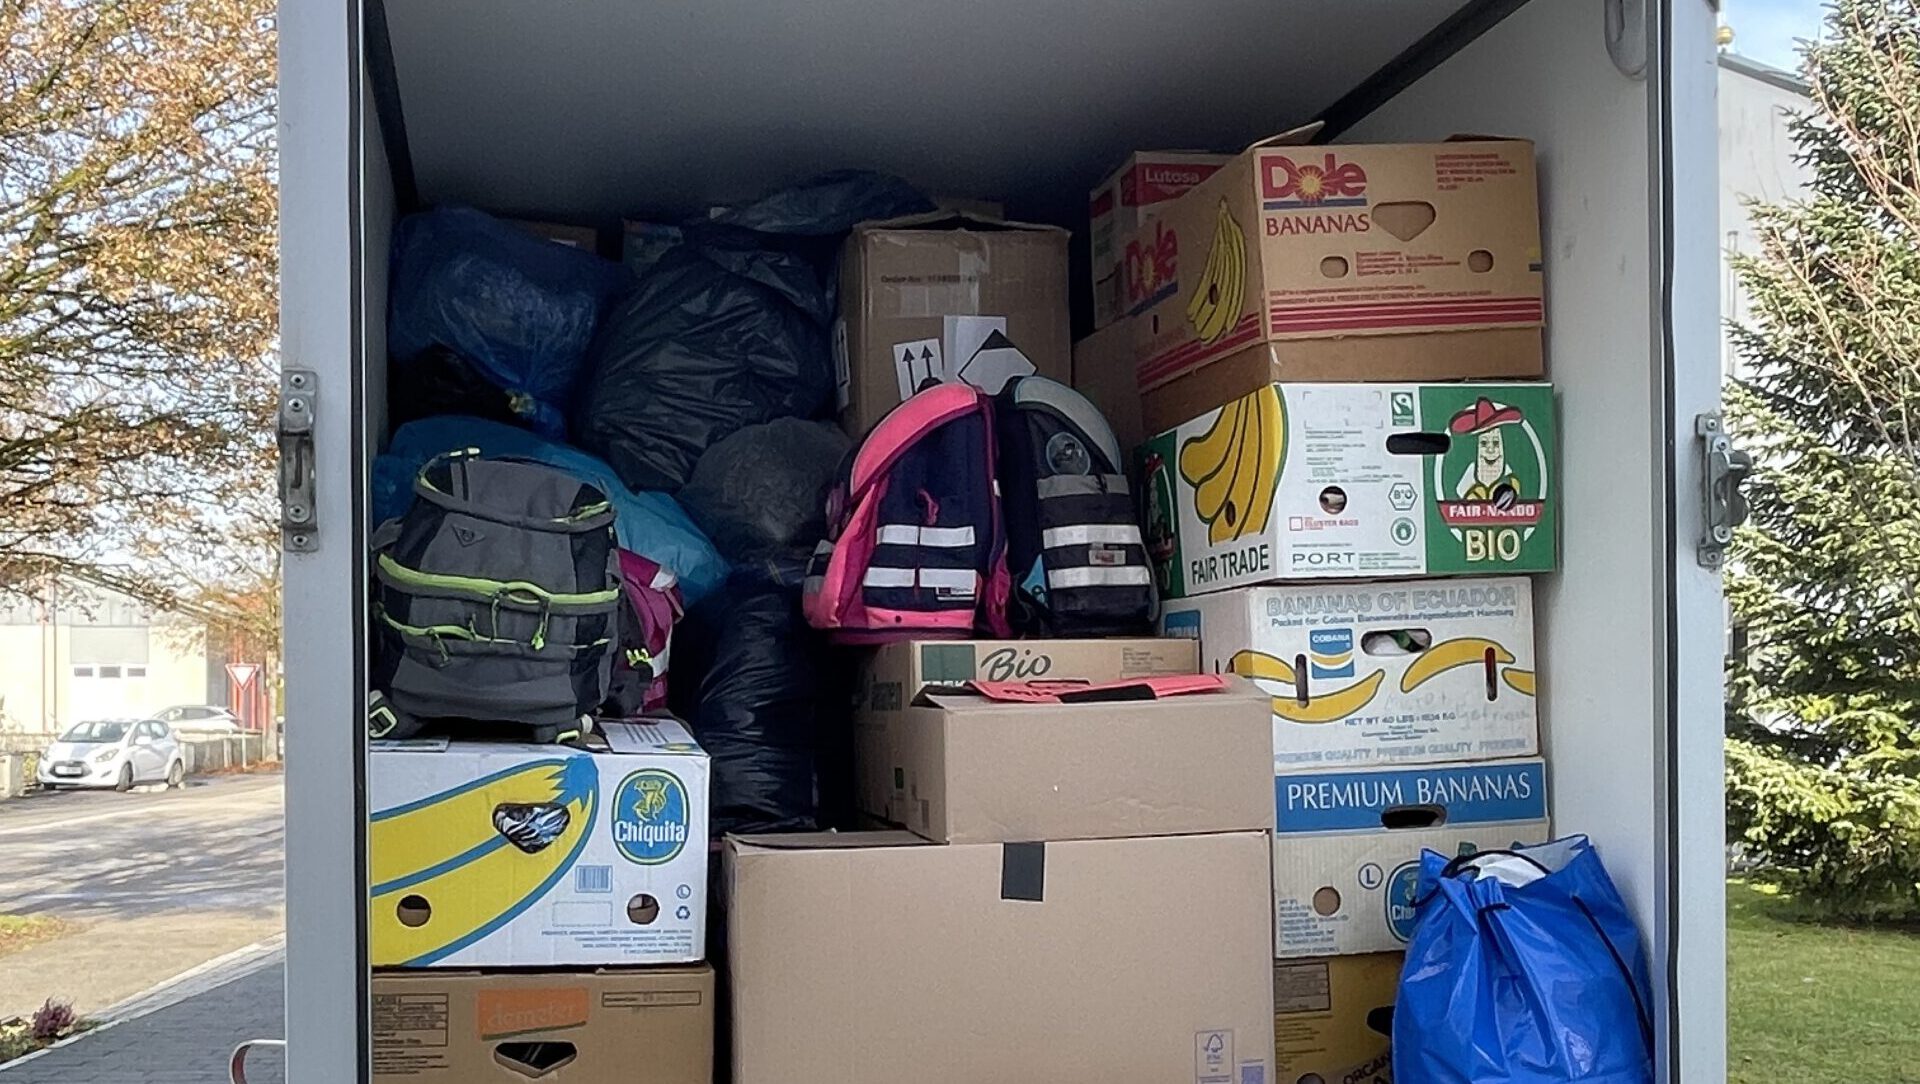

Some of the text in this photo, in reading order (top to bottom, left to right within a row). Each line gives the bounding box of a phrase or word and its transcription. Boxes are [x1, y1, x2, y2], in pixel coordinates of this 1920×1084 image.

[1145, 168, 1199, 183] Lutosa
[1260, 153, 1367, 201] Dole
[1265, 213, 1370, 236] BANANAS
[1292, 552, 1355, 564] PORT
[1465, 529, 1521, 561] BIO
[1191, 544, 1269, 585] FAIR TRADE
[1267, 586, 1516, 616] BANANAS OF ECUADOR
[980, 648, 1052, 682] Bio
[1325, 749, 1371, 760] QUALITY
[1428, 742, 1473, 754] QUALITY
[1287, 772, 1531, 810] PREMIUM BANANAS
[614, 820, 685, 848] Chiquita
